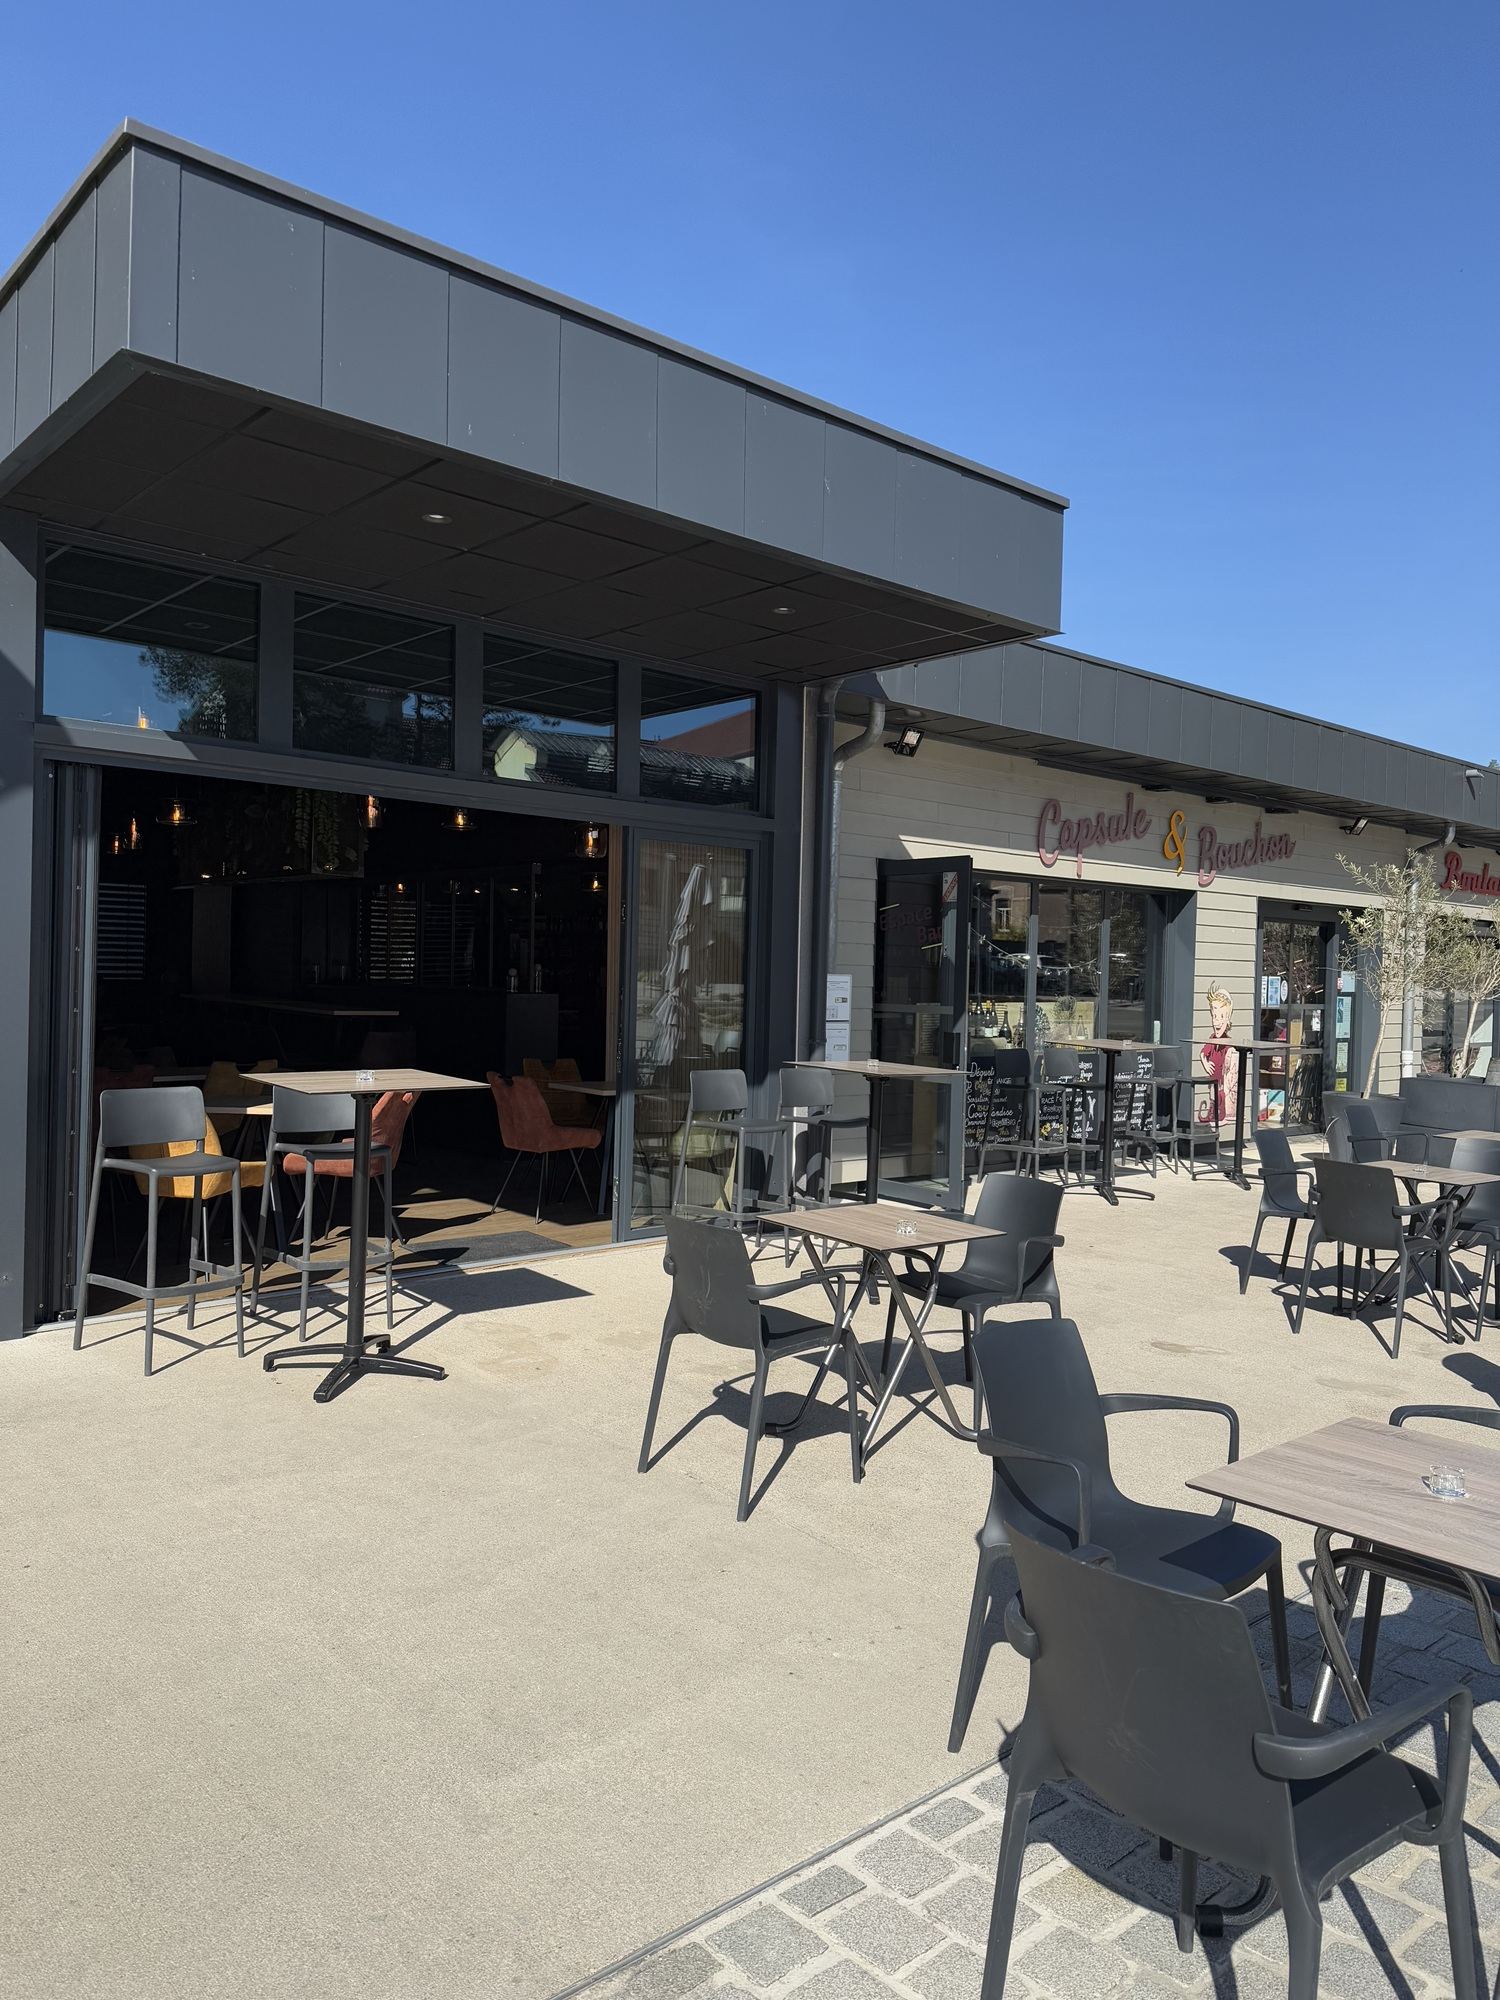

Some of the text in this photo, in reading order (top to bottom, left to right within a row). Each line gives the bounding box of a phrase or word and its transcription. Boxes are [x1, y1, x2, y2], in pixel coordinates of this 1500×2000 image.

[1038, 791, 1296, 888] Capsule & Bouchon
